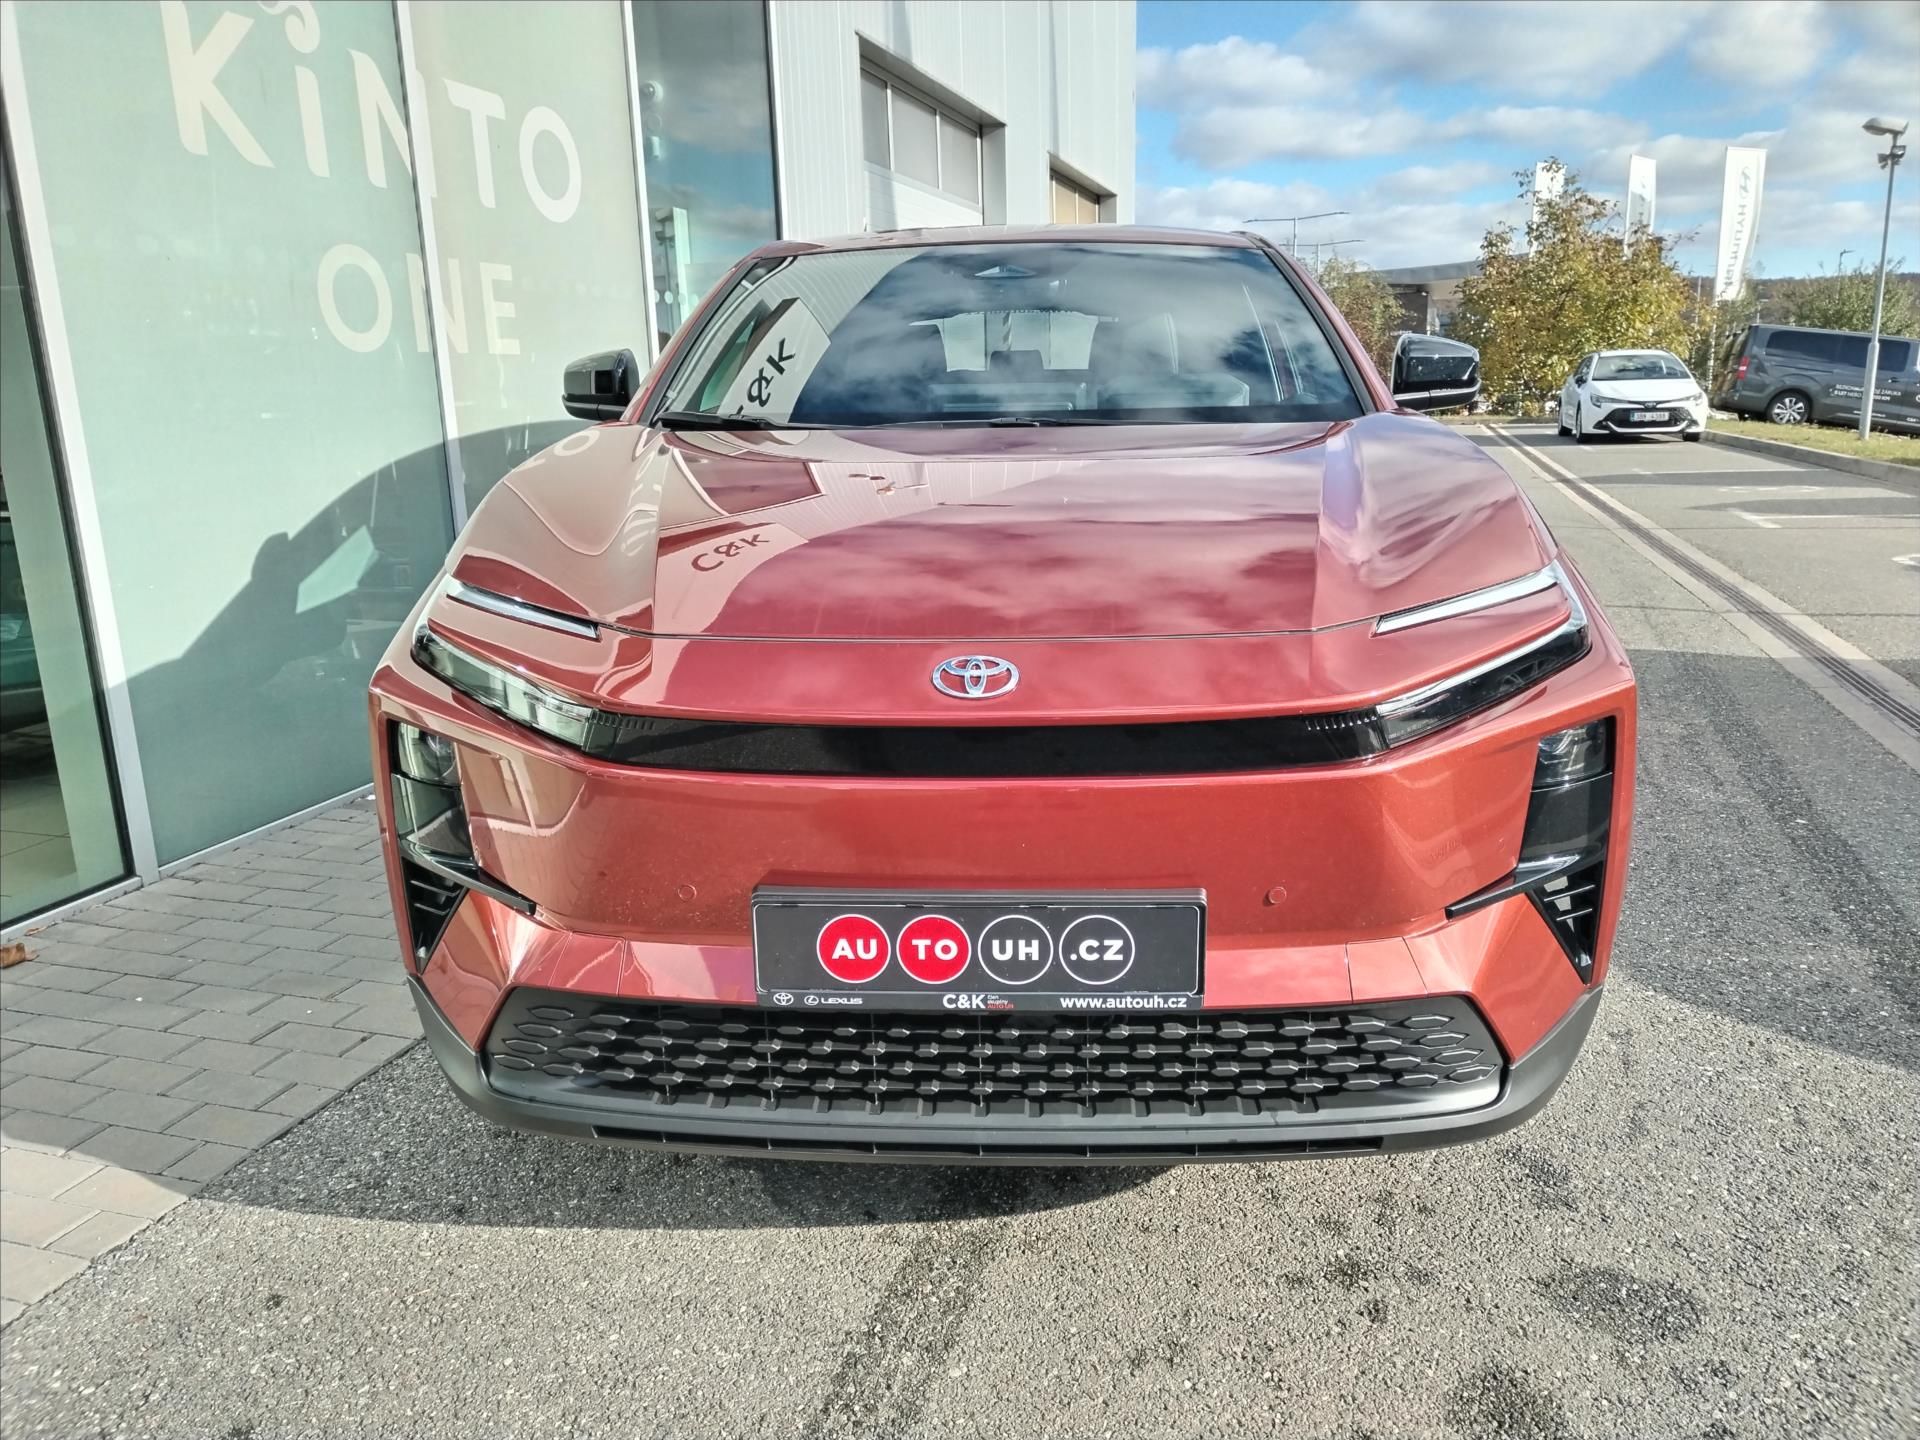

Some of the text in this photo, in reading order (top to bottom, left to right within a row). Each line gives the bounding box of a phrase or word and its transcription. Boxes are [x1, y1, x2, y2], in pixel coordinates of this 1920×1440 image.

[317, 243, 521, 355] ONE
[831, 938, 1124, 961] AU TO UH .CZ
[821, 997, 863, 1005] LEXUS
[942, 993, 986, 1009] C&K
[1060, 995, 1187, 1009] www.autouh.cz
